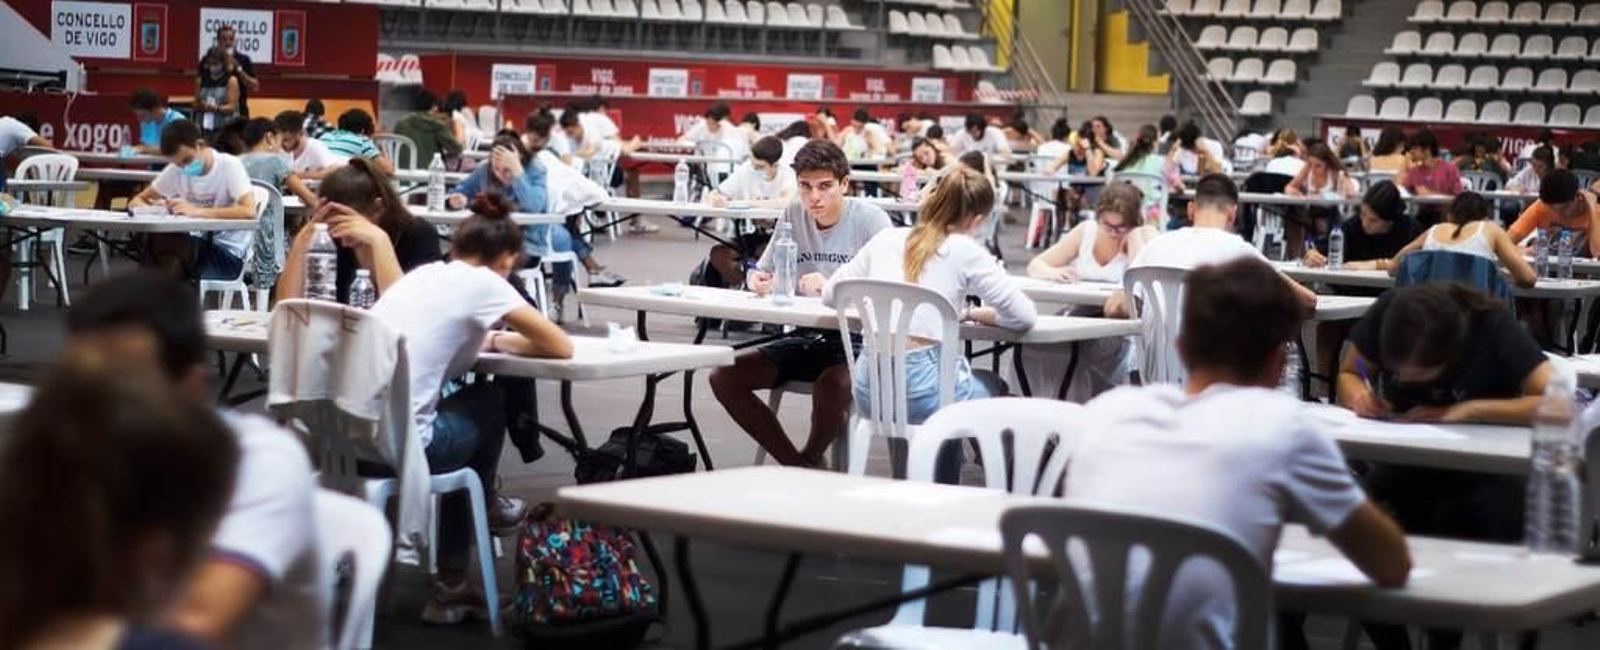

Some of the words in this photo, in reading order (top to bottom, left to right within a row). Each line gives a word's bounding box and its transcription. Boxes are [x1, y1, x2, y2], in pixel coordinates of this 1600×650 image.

[57, 12, 125, 29] CONCELLO
[65, 30, 82, 46] DE
[86, 31, 117, 47] VIGO
[63, 124, 122, 153] xogo
